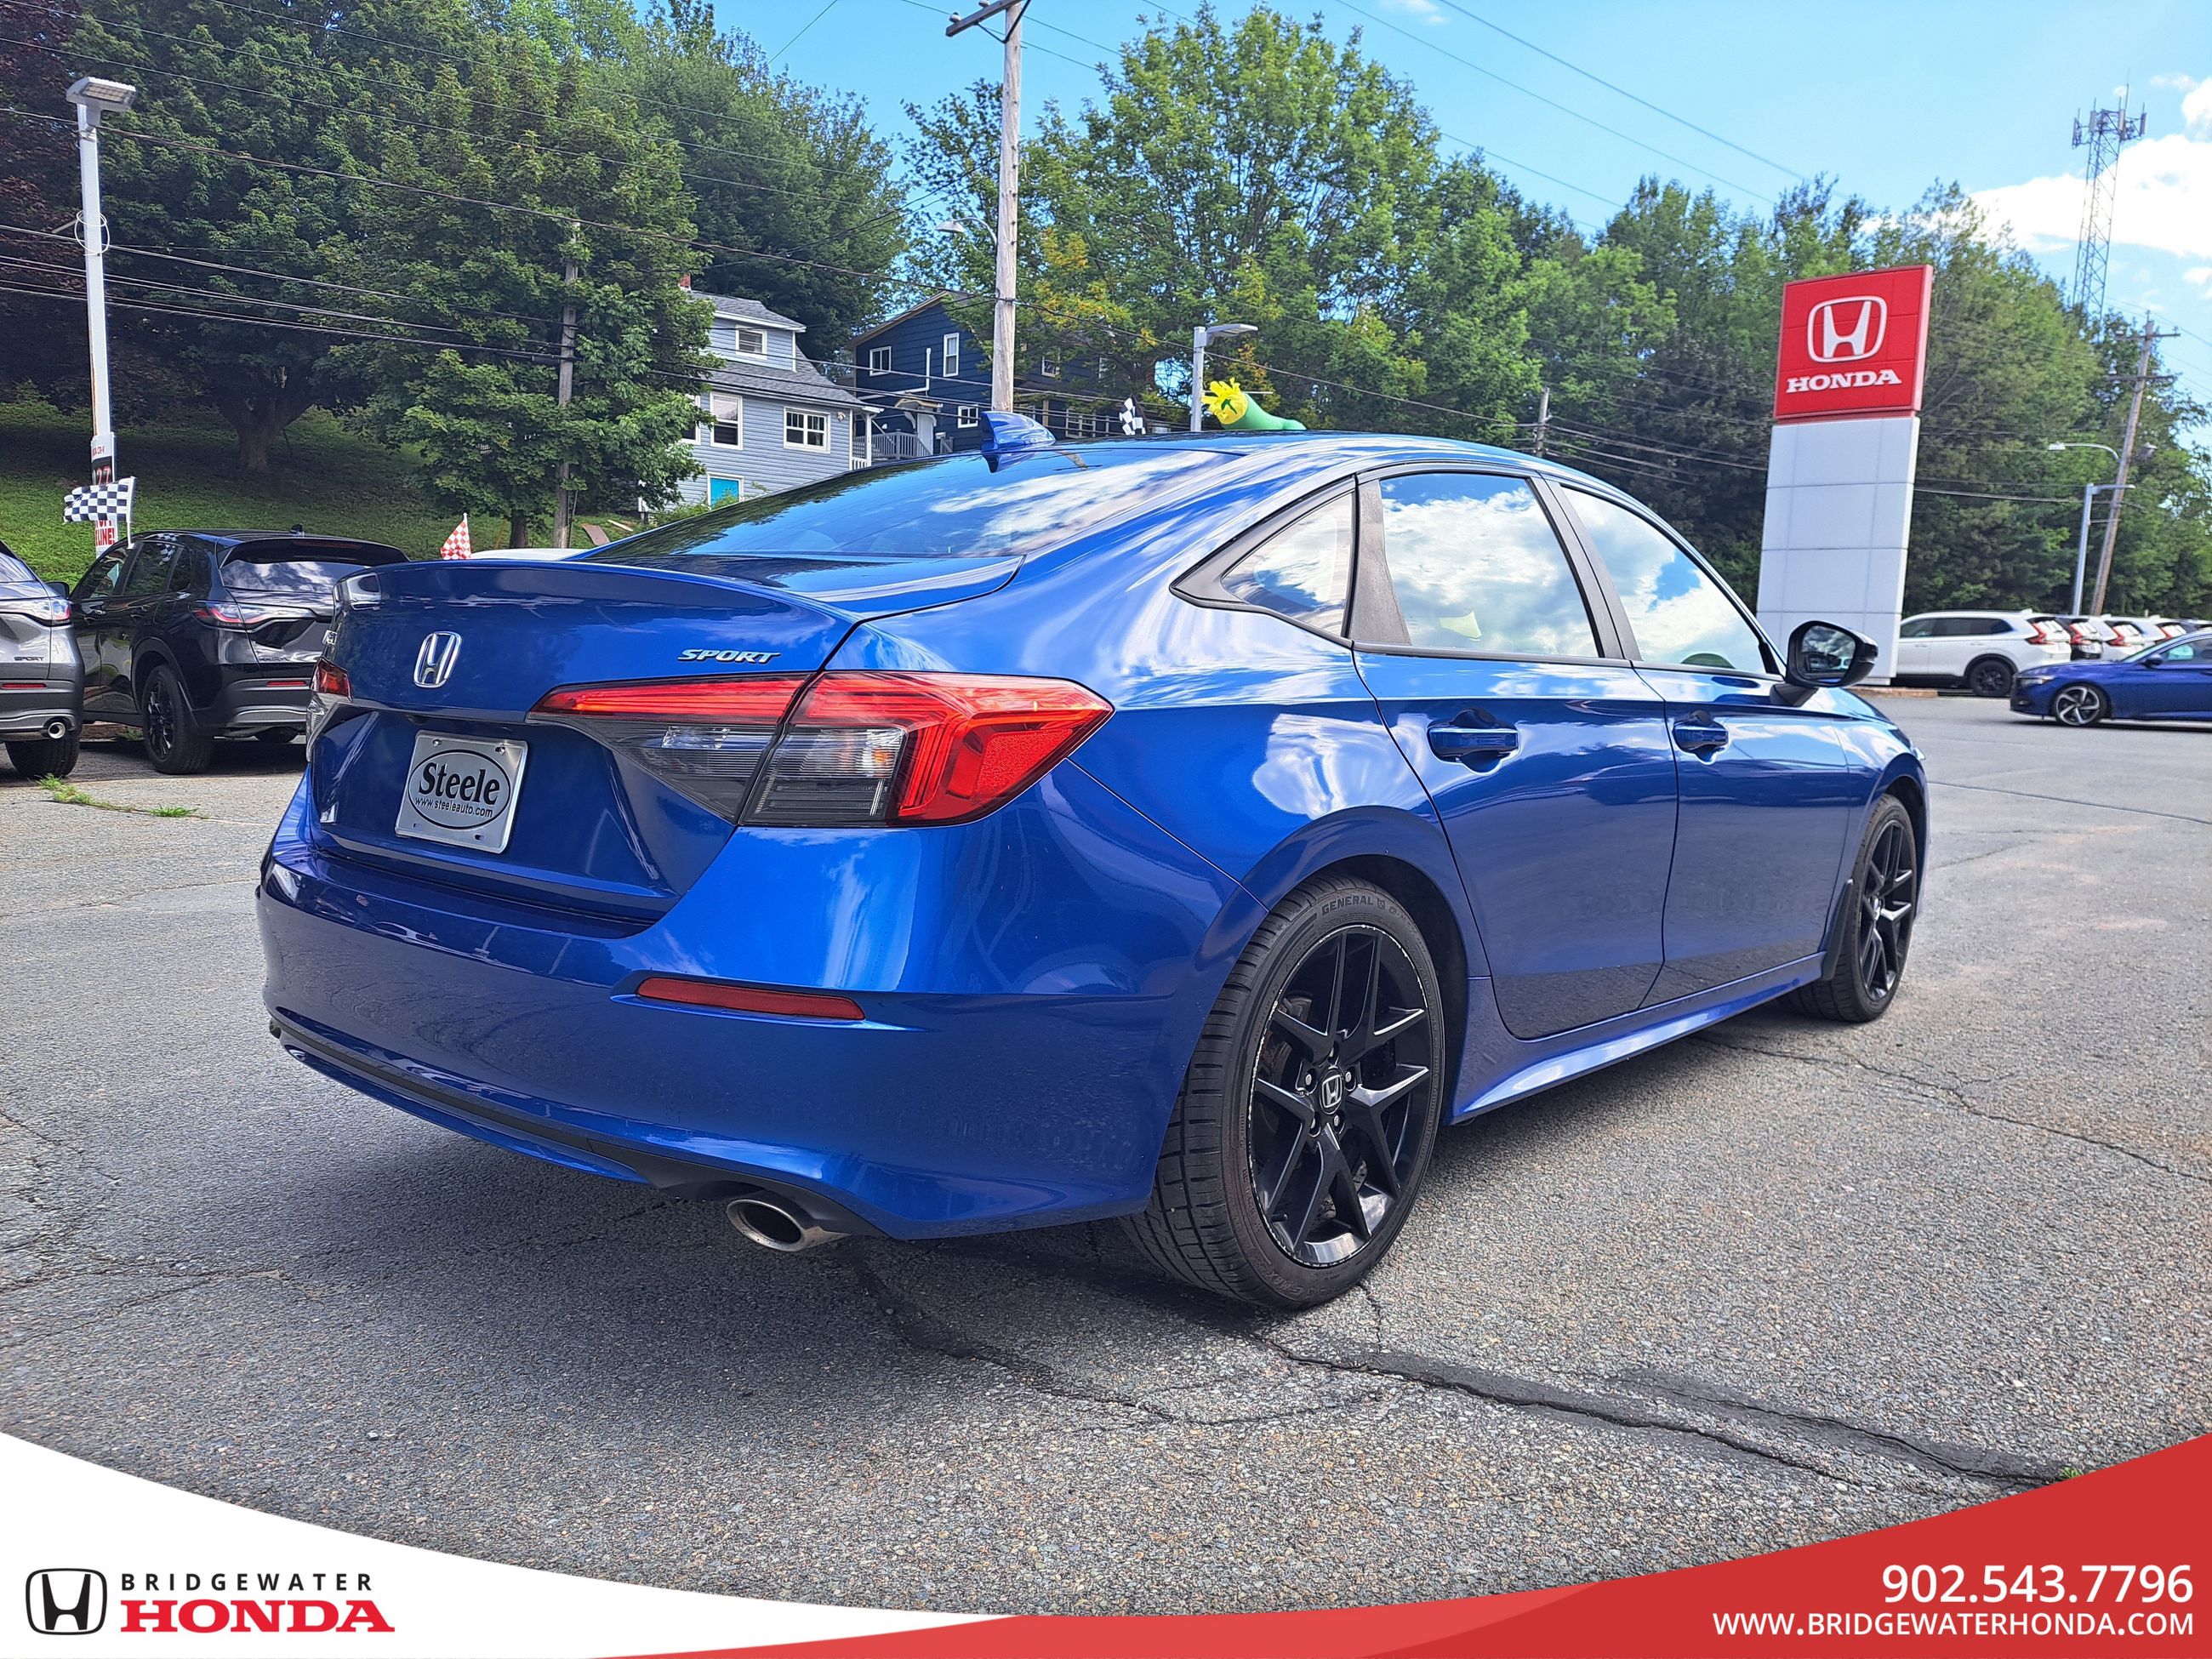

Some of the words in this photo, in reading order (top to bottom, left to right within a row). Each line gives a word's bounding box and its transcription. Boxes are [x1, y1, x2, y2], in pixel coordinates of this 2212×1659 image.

[1786, 368, 1902, 393] HONDA
[677, 648, 782, 664] SPORT
[418, 761, 500, 806] Steele
[415, 796, 493, 818] www.steeleauto.com
[1322, 895, 1374, 915] GENERAL
